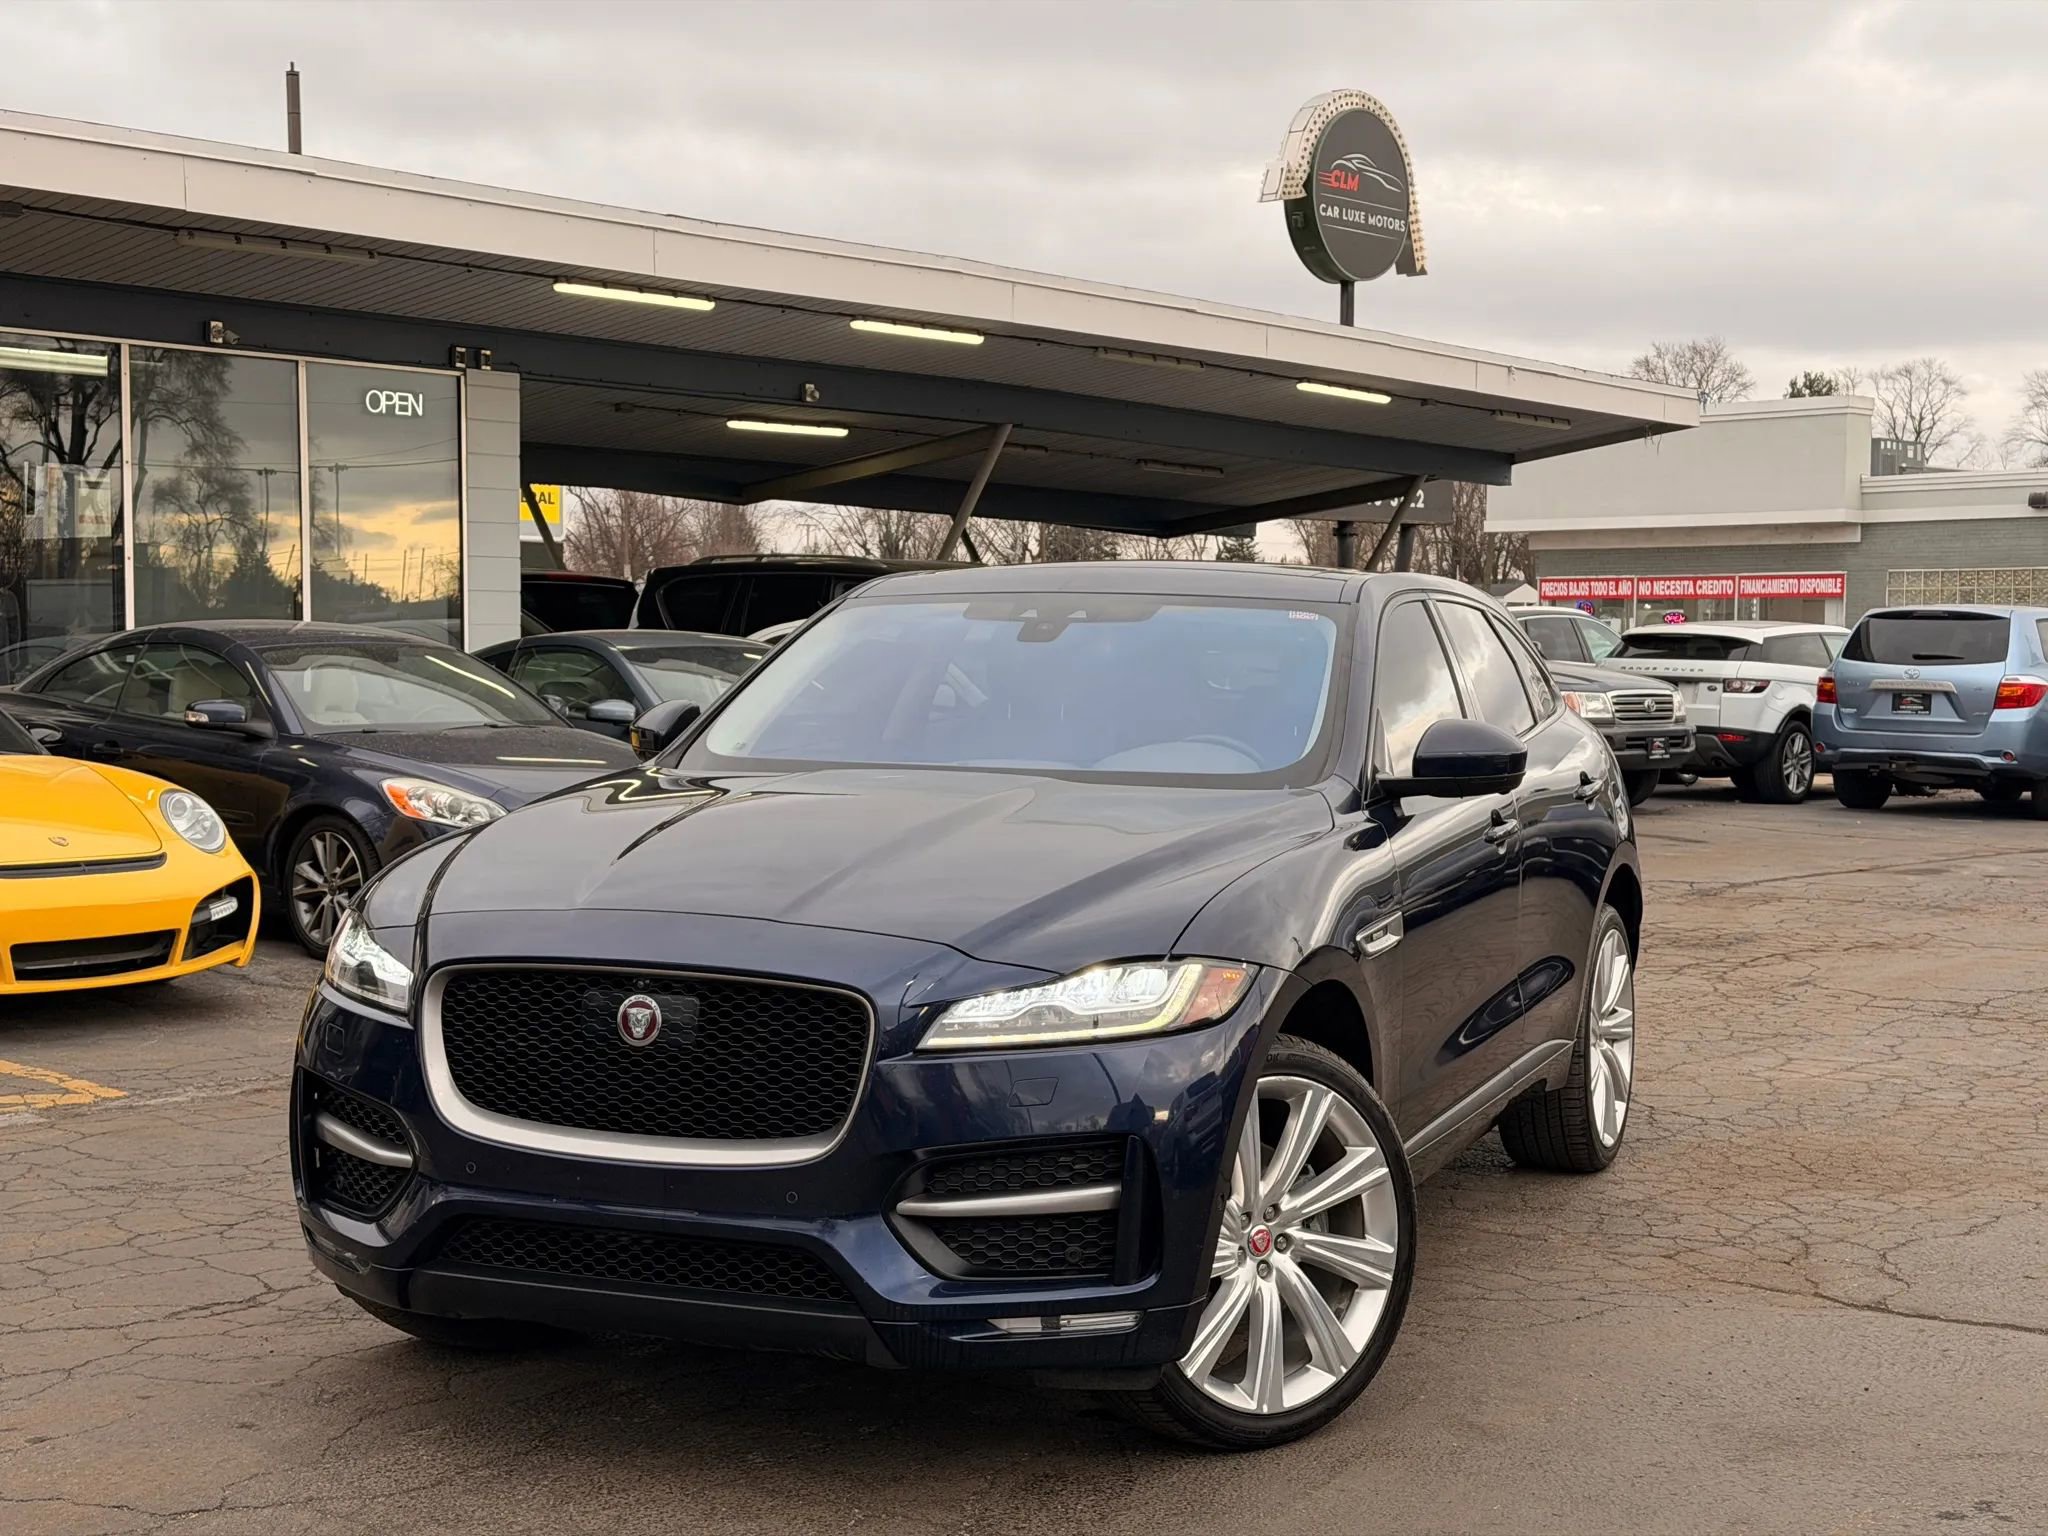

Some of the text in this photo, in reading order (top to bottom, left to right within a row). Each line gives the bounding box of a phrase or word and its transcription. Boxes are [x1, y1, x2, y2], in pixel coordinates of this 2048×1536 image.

[1330, 169, 1360, 192] CLM
[1319, 203, 1406, 232] CAR LUXE MOTORS
[365, 389, 423, 417] OPEN
[1541, 579, 1632, 597] PRECIOS BAJOS TODO EL AÑO
[1638, 579, 1734, 596] NO NECESITA CREDITO
[1740, 577, 1842, 594] FINANCIAMIENTO DISPONIBLE
